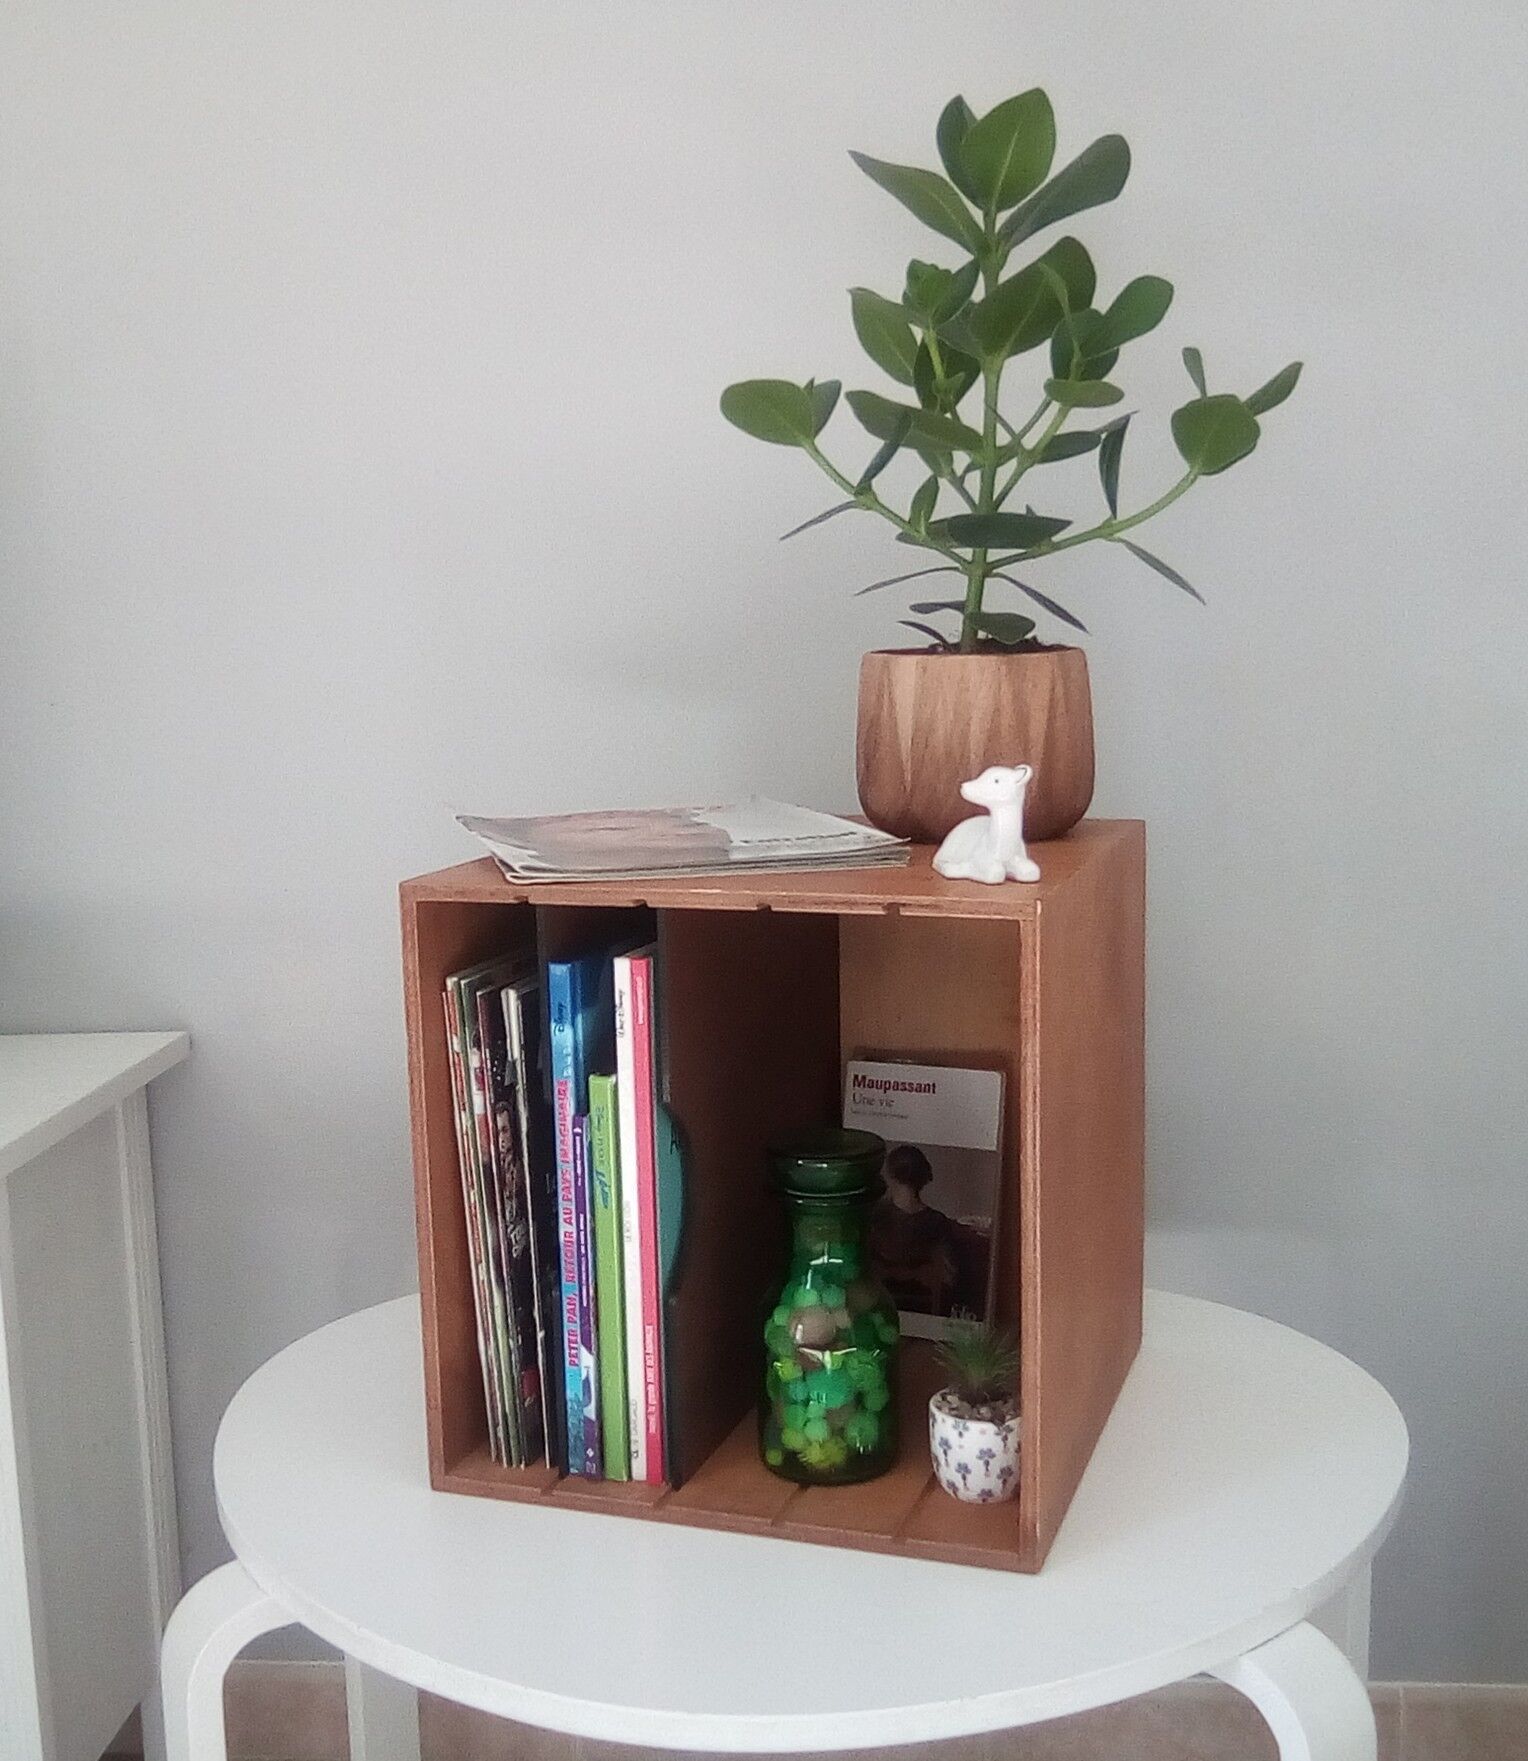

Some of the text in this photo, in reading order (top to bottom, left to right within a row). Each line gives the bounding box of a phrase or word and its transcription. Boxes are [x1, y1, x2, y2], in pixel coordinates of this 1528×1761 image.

[852, 1092, 895, 1108] Une vie
[853, 1074, 937, 1094] Maupassant
[557, 1080, 571, 1163] IMAGINAIRE
[562, 1169, 573, 1202] PAYS
[563, 1207, 574, 1226] AU
[564, 1231, 577, 1284] RETOUR
[568, 1329, 580, 1367] PETER
